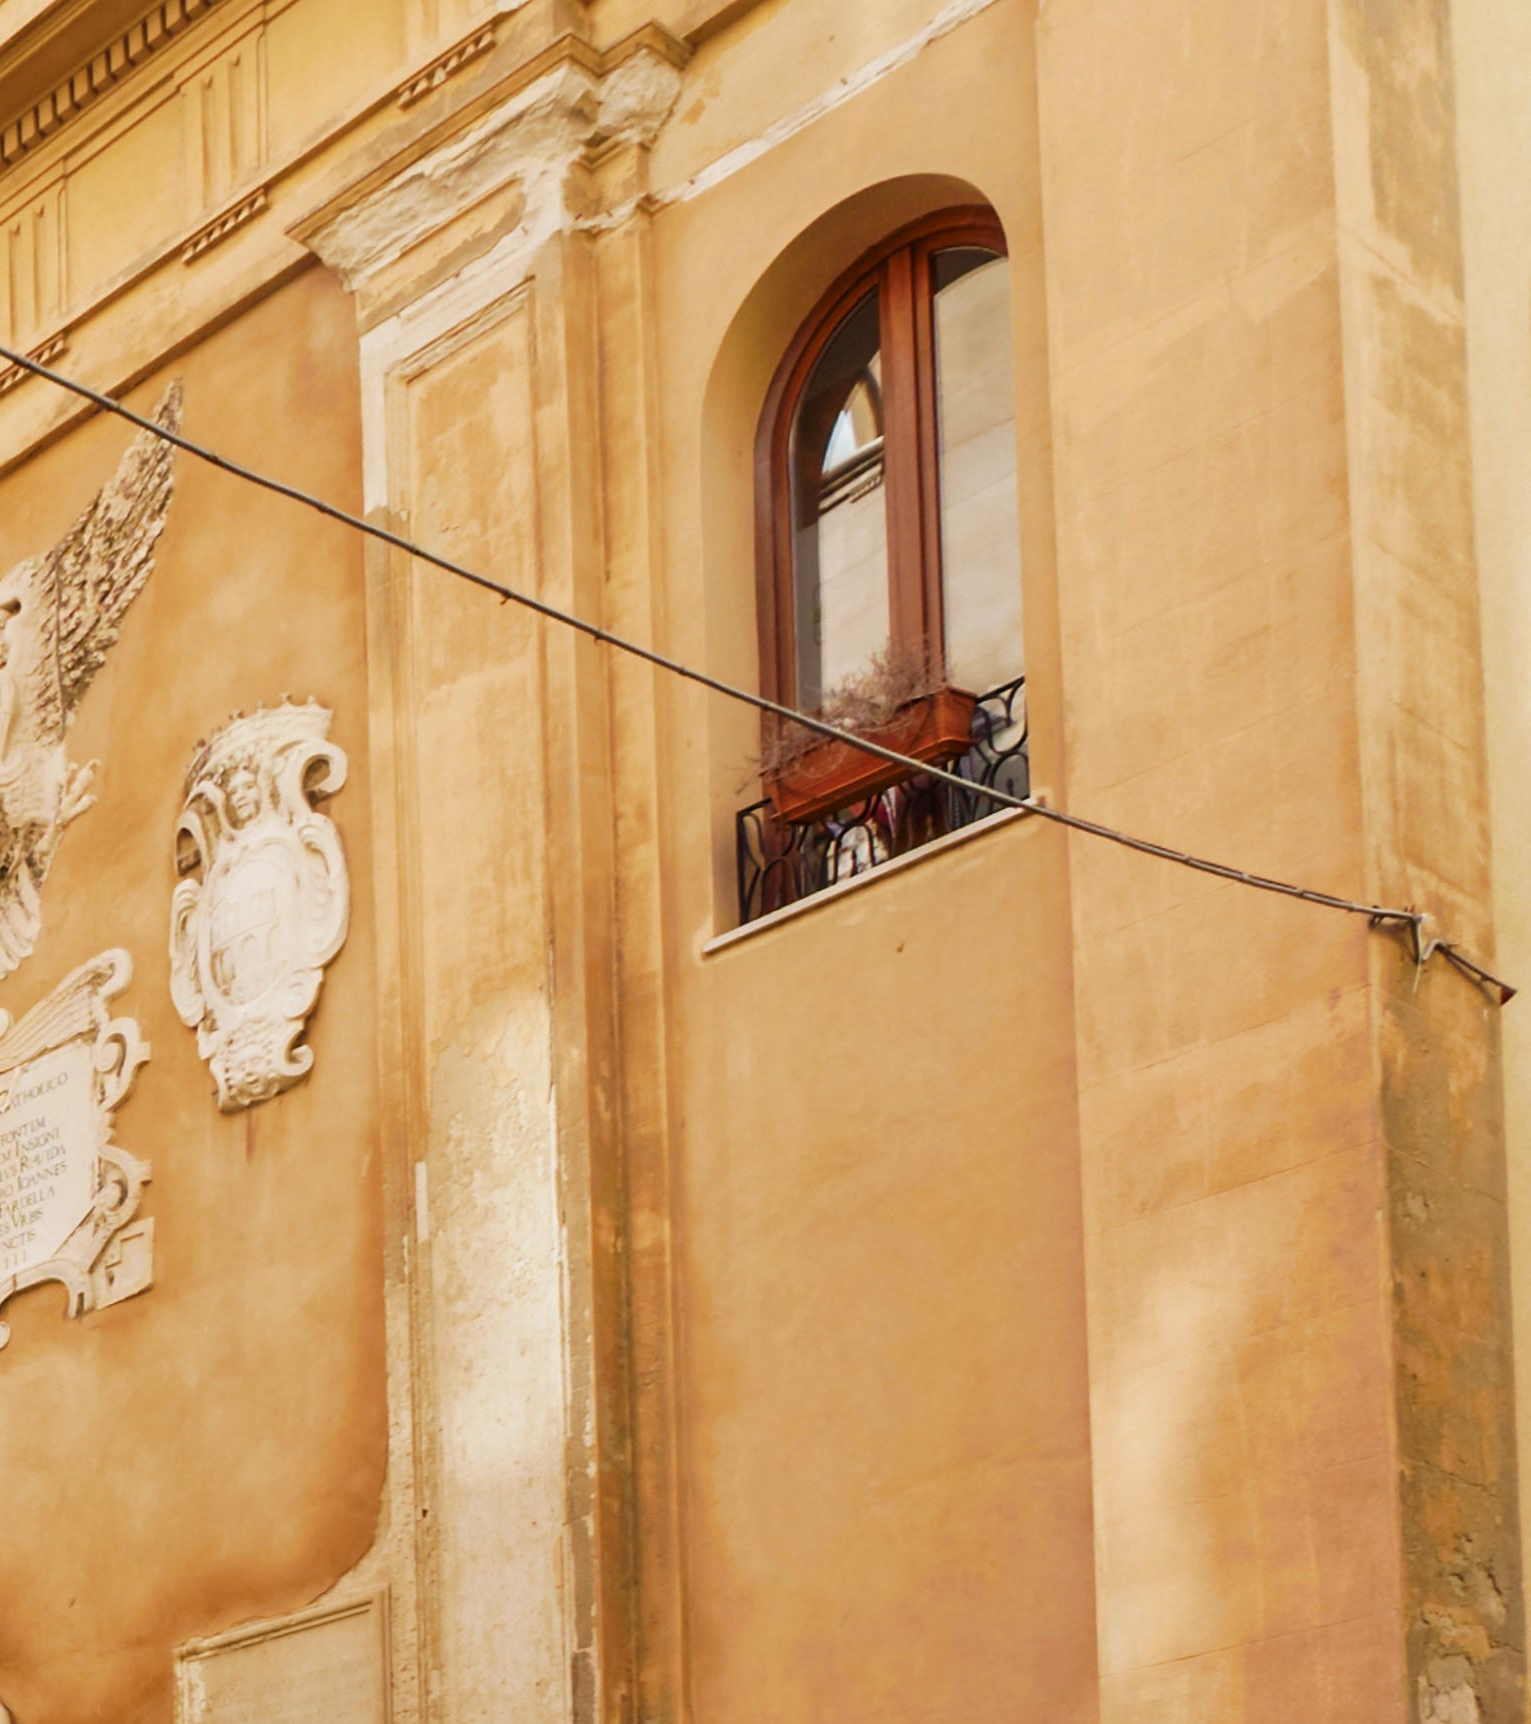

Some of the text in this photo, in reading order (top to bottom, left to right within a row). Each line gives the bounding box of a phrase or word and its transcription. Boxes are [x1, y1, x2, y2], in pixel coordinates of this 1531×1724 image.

[1, 1115, 45, 1146] FONTEM
[15, 1126, 59, 1156] INSIGNI
[17, 1159, 67, 1191] IOANNES
